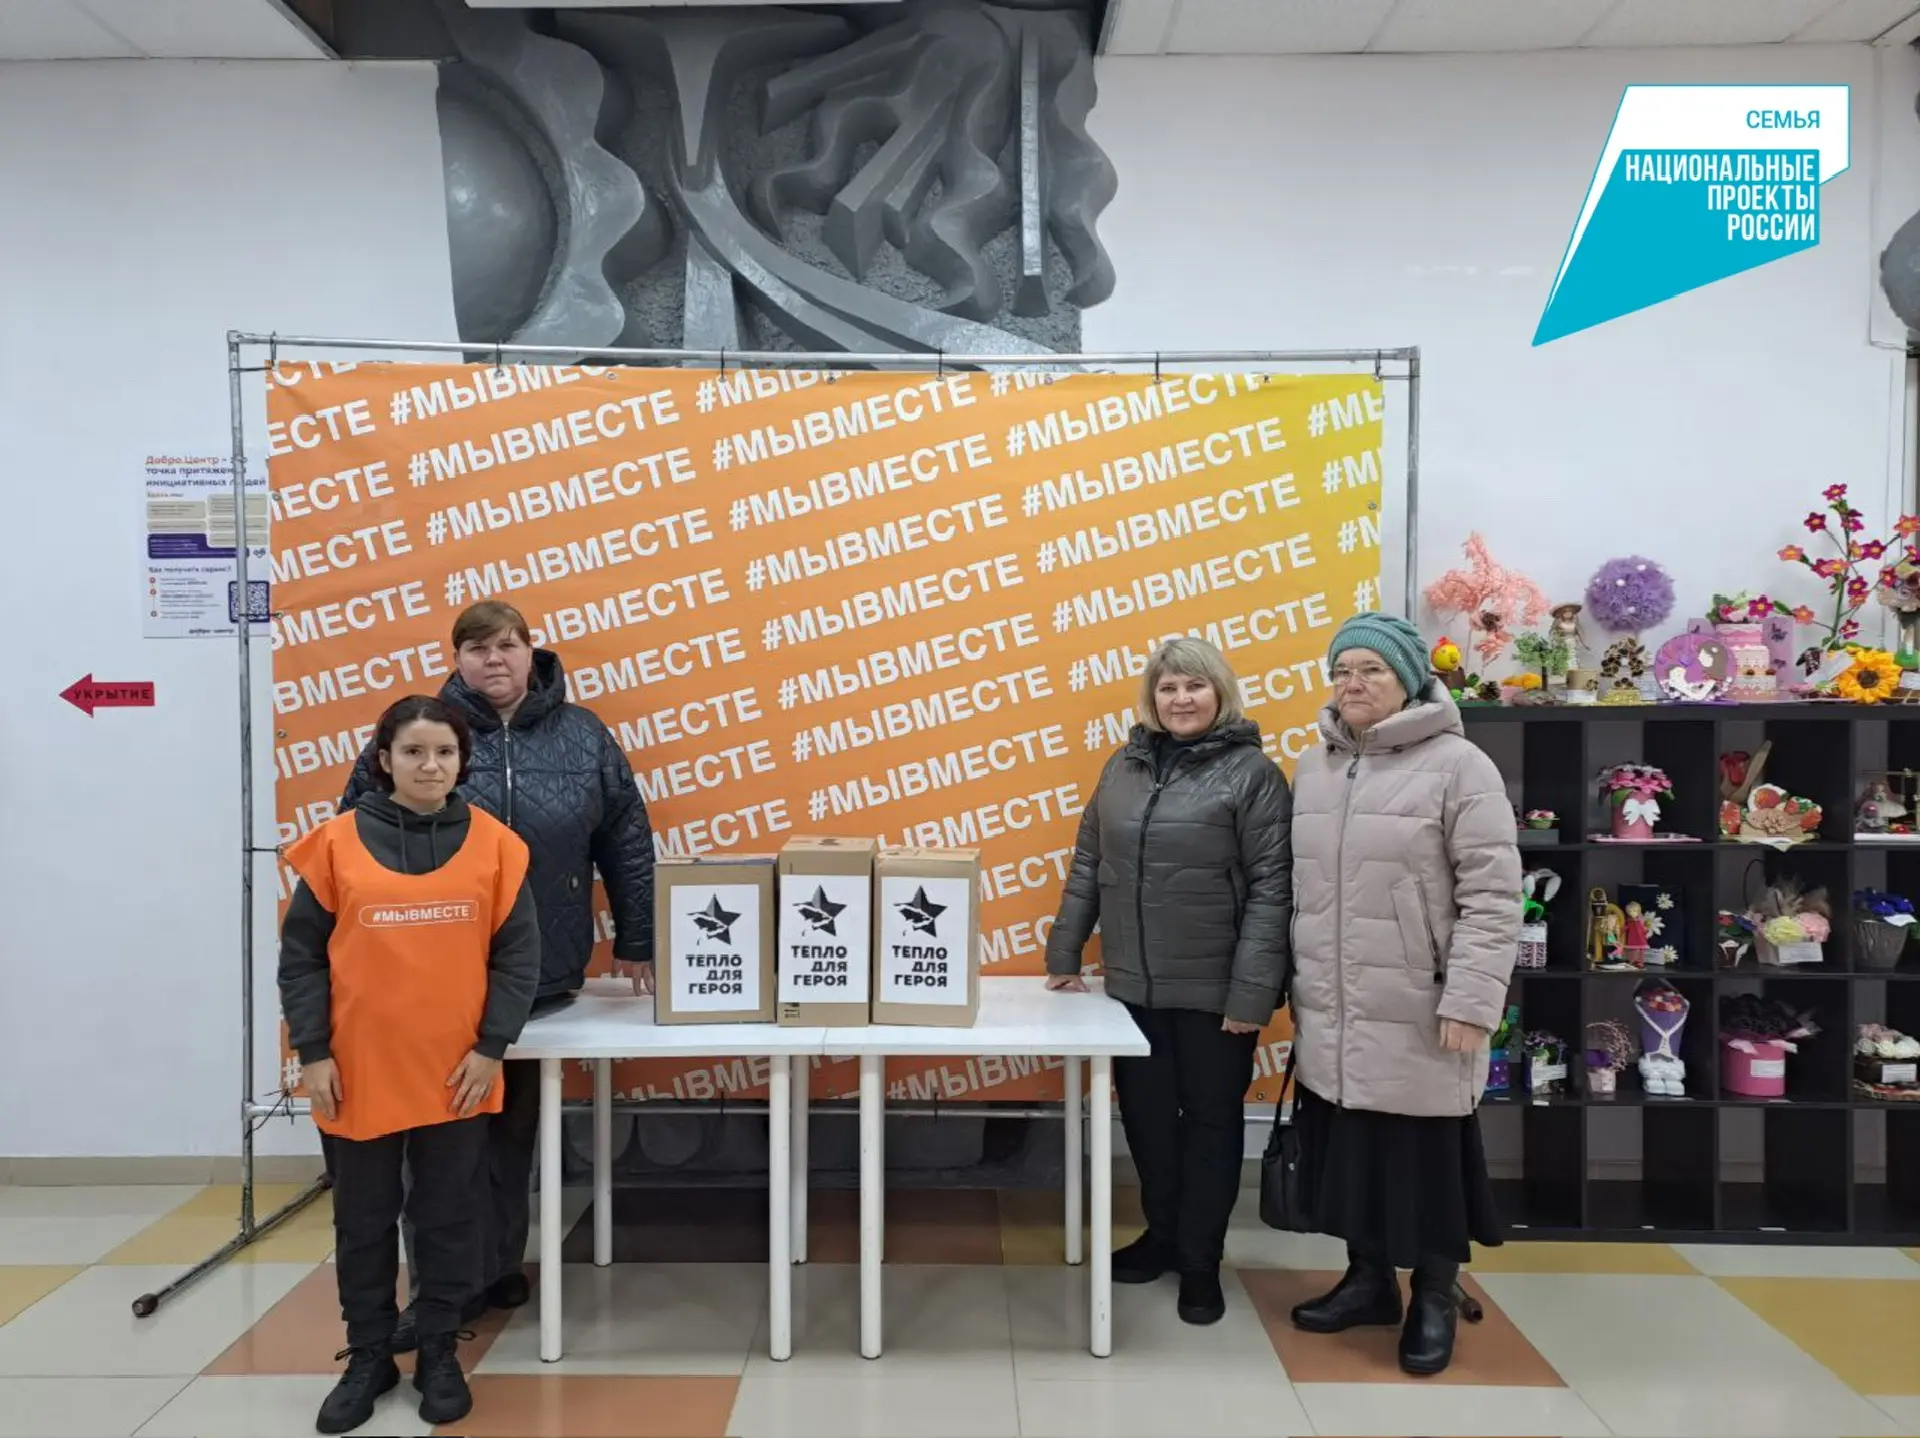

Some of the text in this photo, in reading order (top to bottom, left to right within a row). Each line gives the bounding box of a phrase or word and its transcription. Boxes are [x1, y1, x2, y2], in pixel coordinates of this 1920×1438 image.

[390, 365, 607, 426] #МЫВМЕ
[408, 389, 680, 487] #МЫВМЕСТЕ
[427, 447, 696, 546] #МЫВМЕСТЕ
[712, 372, 976, 471] #МЫВМЕСТЕ
[145, 467, 247, 478] точка притяжен
[747, 493, 1008, 591] #МЫВМЕСТЕ
[1023, 418, 1286, 517] #МЫВМЕСТЕ
[446, 508, 714, 606] #МЫВМЕСТЕ
[730, 433, 992, 531] #МЫВМЕСТЕ
[763, 553, 1025, 650] #МЫВМЕСТЕ
[1038, 473, 1301, 573] #МЫВМЕСТЕ
[779, 613, 1040, 709] #МЫВМЕСТЕ
[1053, 533, 1316, 633] #МЫВМЕСТЕ
[73, 688, 150, 700] УКРЫТИЕ
[794, 665, 1053, 762] #МЫВМЕСТЕ
[810, 724, 1068, 822] #МЫВМЕСТЕ
[373, 905, 470, 923] #МЫВМЕСТЕ
[791, 945, 848, 959] ТЕПЛО
[891, 945, 948, 960] ТЕПЛО
[685, 954, 743, 967] ТЕПЛО
[811, 961, 848, 973] ДЛЯ
[911, 961, 948, 974] ДЛЯ
[706, 969, 743, 982] ДЛЯ
[793, 974, 848, 987] ГЕРОЯ
[893, 975, 948, 988] ГЕРОЯ
[688, 983, 743, 995] ГЕРОЯ
